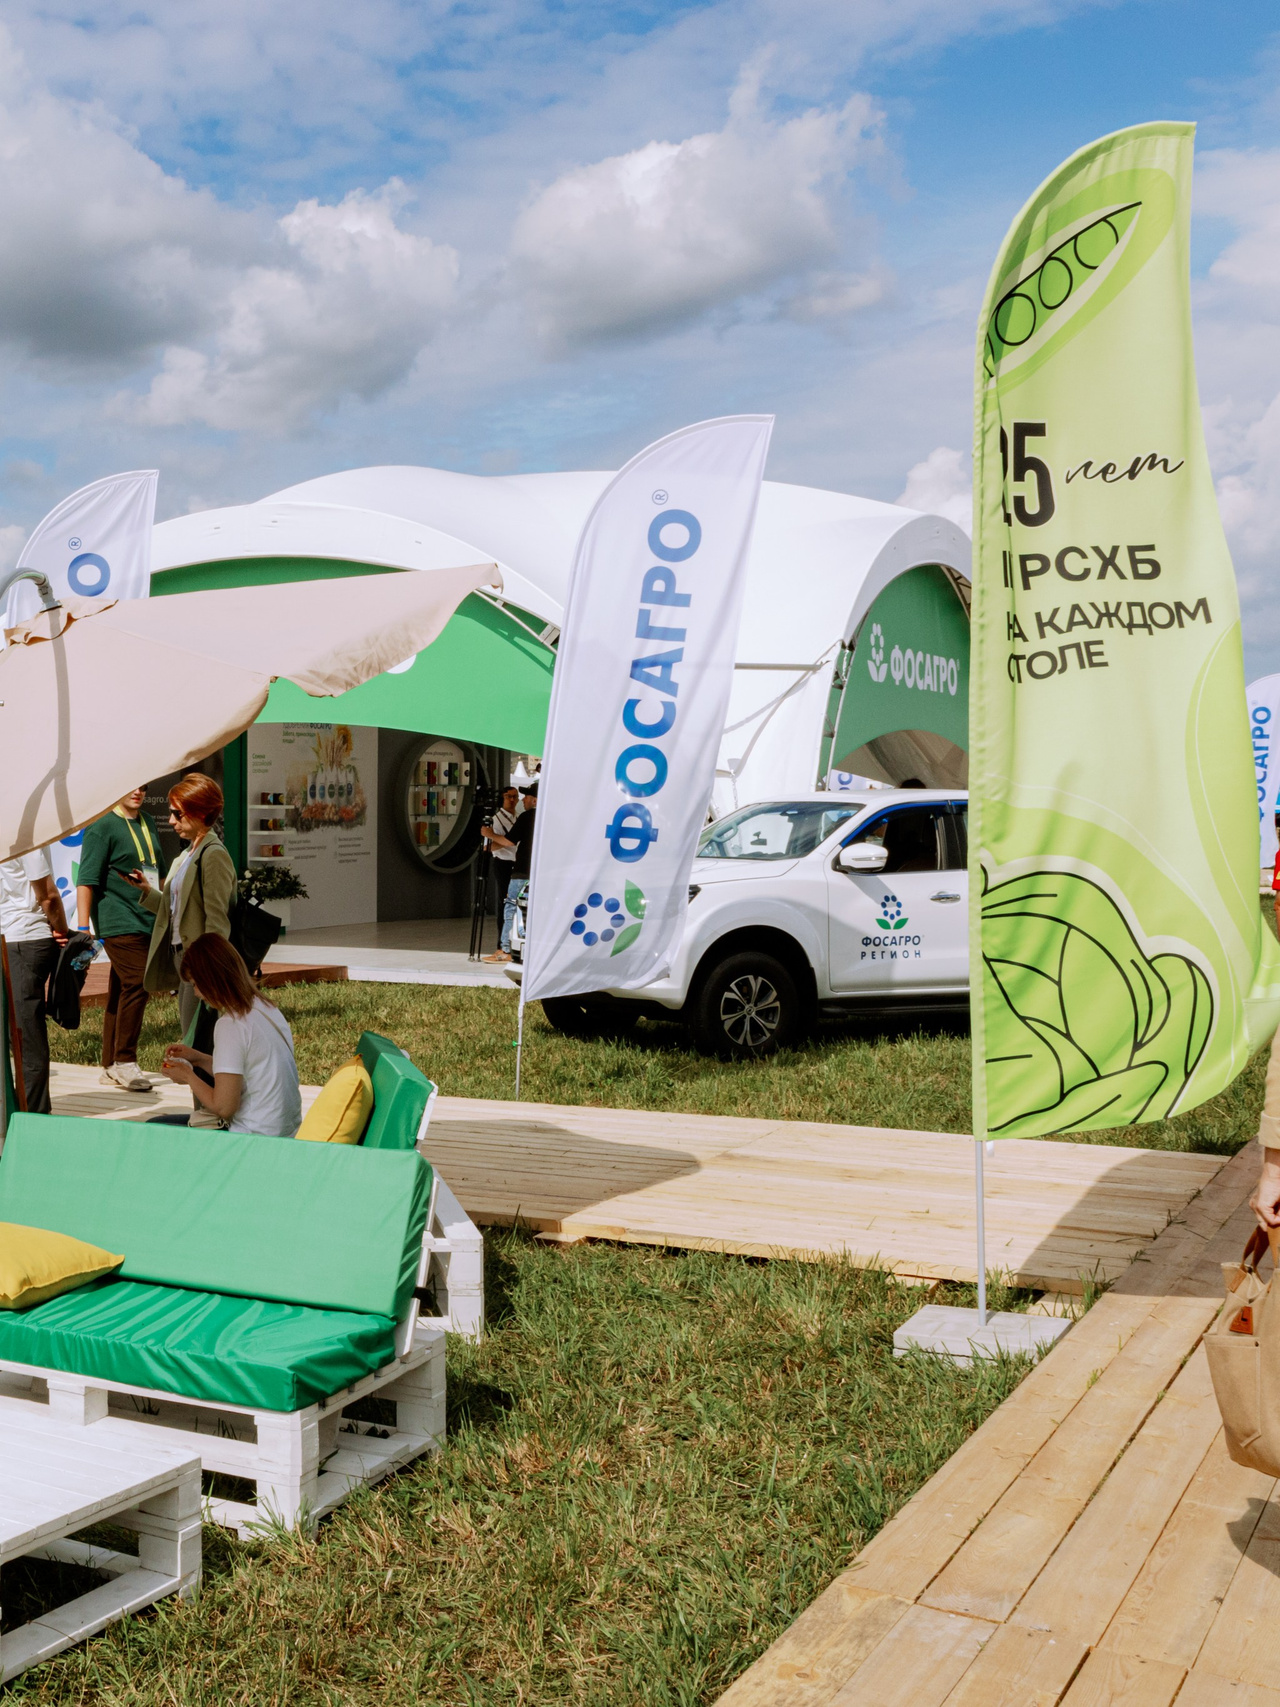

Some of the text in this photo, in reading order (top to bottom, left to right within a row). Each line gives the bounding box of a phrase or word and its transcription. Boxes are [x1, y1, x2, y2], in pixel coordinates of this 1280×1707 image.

[1065, 452, 1185, 484] лет
[1034, 597, 1213, 639] КАЖДОМ
[861, 935, 921, 947] ФОСАГРО
[860, 950, 921, 960] РЕГИОН
